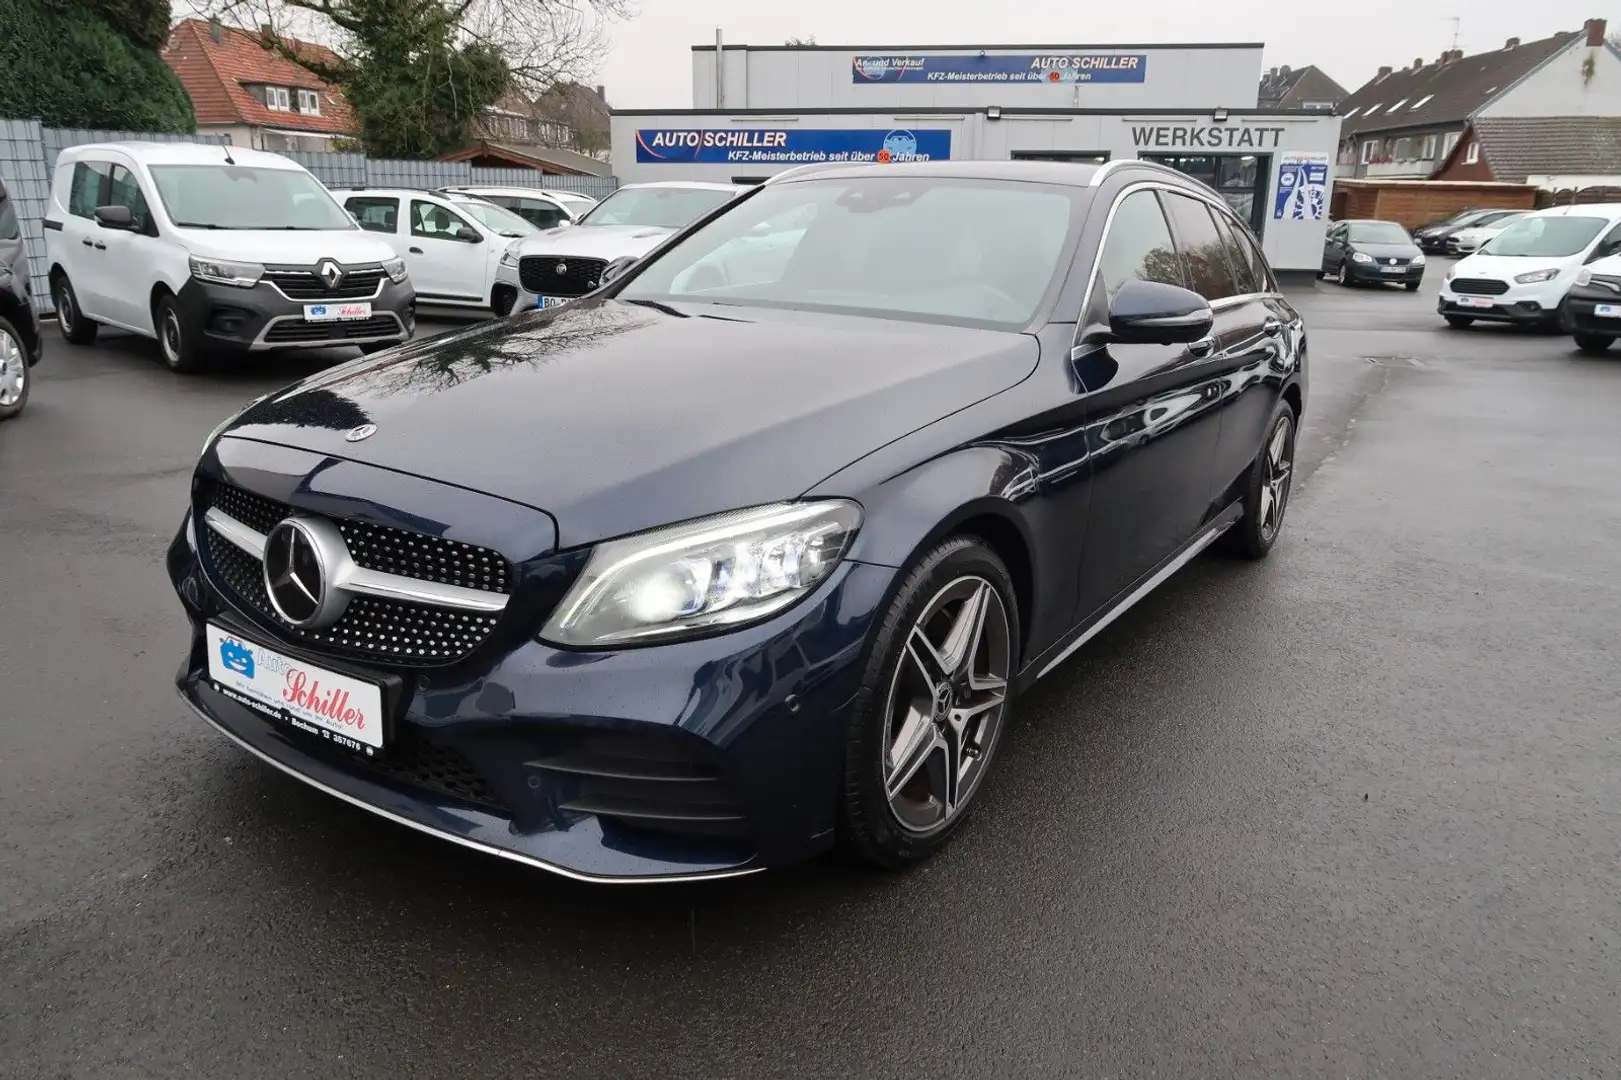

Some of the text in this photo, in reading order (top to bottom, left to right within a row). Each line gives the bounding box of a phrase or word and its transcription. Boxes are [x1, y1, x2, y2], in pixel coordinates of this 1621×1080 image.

[873, 58, 889, 67] und
[891, 58, 925, 67] Verkauf
[1031, 57, 1139, 69] AUTO SCHILLER
[927, 71, 1007, 81] KFZ-Meisterbetrieb
[1009, 72, 1025, 80] seit
[1027, 71, 1046, 80] über
[652, 132, 787, 147] AUTO SCHILLER
[1132, 127, 1285, 147] WERKSTATT
[728, 150, 826, 161] KFZ-Meisterbetrieb
[828, 151, 848, 161] seit
[851, 150, 876, 161] über
[892, 151, 930, 161] Jahren
[283, 668, 366, 730] Schiller
[222, 687, 282, 720] www.auto-schiller.de
[291, 717, 319, 735] Bochum
